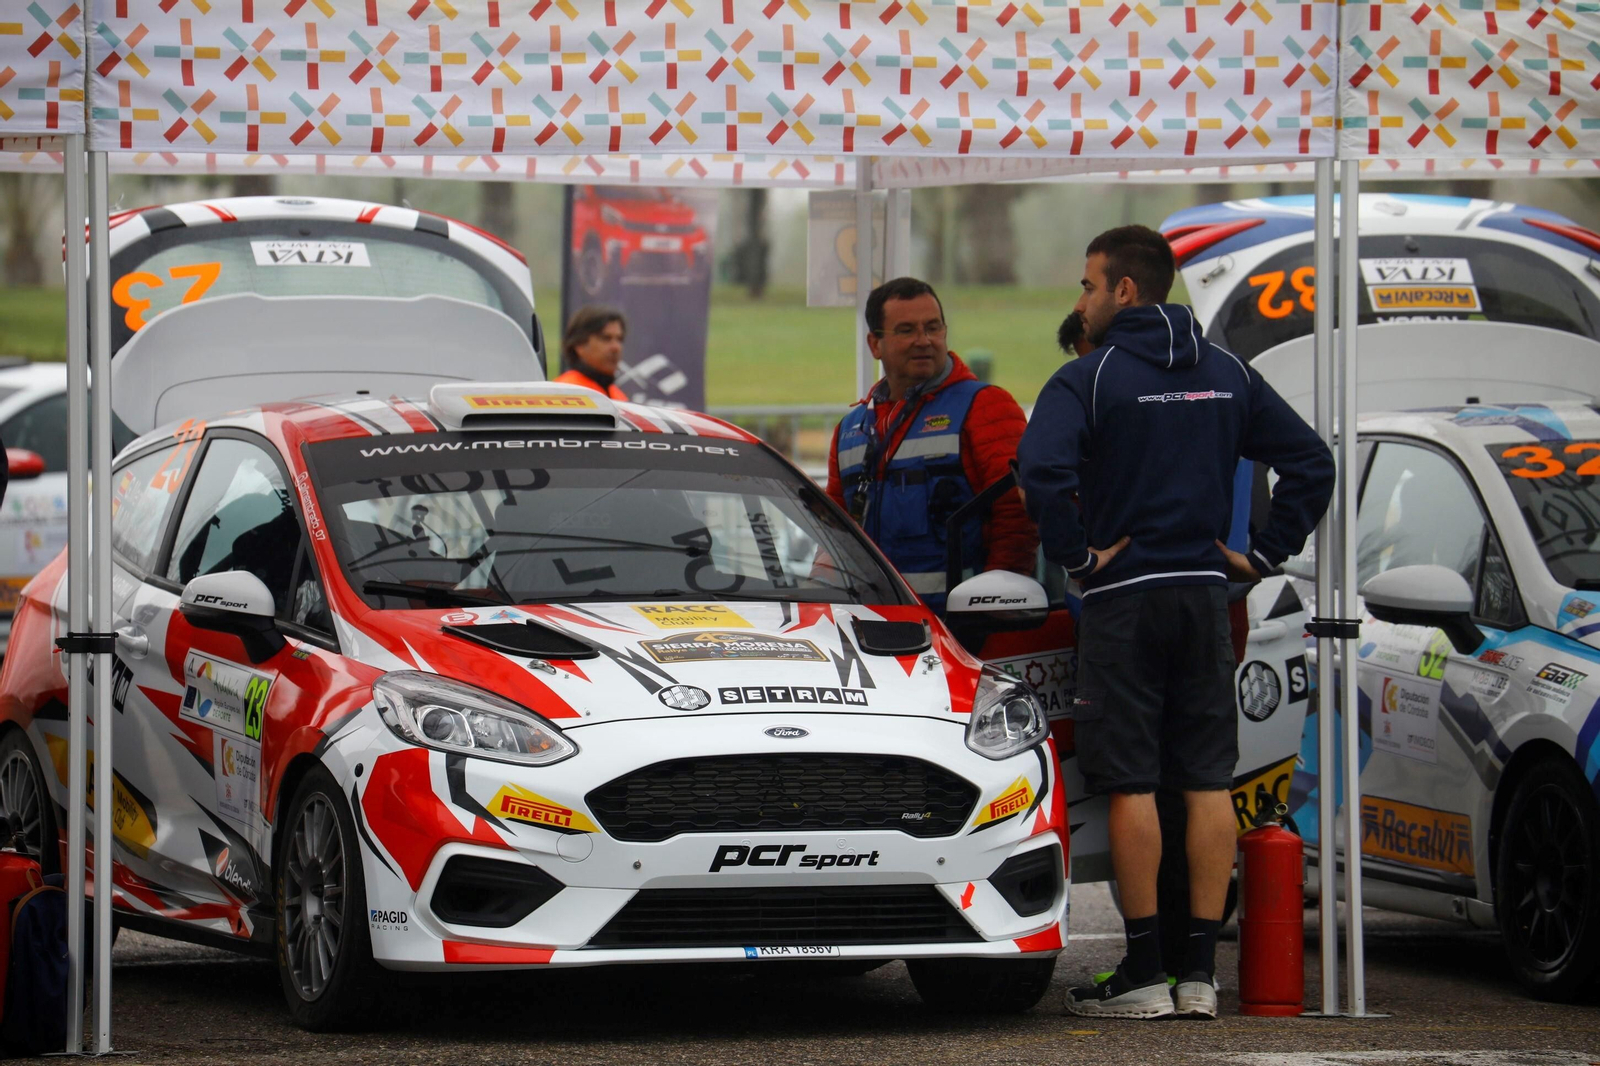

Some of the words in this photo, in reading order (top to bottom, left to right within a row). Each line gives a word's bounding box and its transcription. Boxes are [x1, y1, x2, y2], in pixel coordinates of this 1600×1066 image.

[267, 249, 354, 264] KTVA
[1375, 267, 1456, 281] KTVA
[1394, 290, 1454, 304] Recalvi
[471, 397, 588, 407] PIRELLI
[1138, 390, 1233, 403] www.pcrsport.com
[360, 437, 740, 458] www.membrado.net
[219, 600, 248, 609] sport
[999, 596, 1028, 605] sport
[638, 605, 728, 614] RACC
[655, 615, 719, 623] Mobility
[652, 642, 722, 651] SIERRA
[724, 640, 809, 650] MORENA
[719, 687, 868, 705] SETRAM
[245, 676, 269, 740] 23
[773, 726, 801, 737] Ford
[989, 787, 1029, 820] PIRELLI
[501, 795, 573, 827] PIRELLI
[1381, 808, 1455, 864] Recalvi
[708, 844, 808, 873] pcr
[798, 850, 880, 871] sport
[377, 910, 408, 924] PAGID
[370, 923, 409, 931] RACING
[760, 946, 792, 955] KRA
